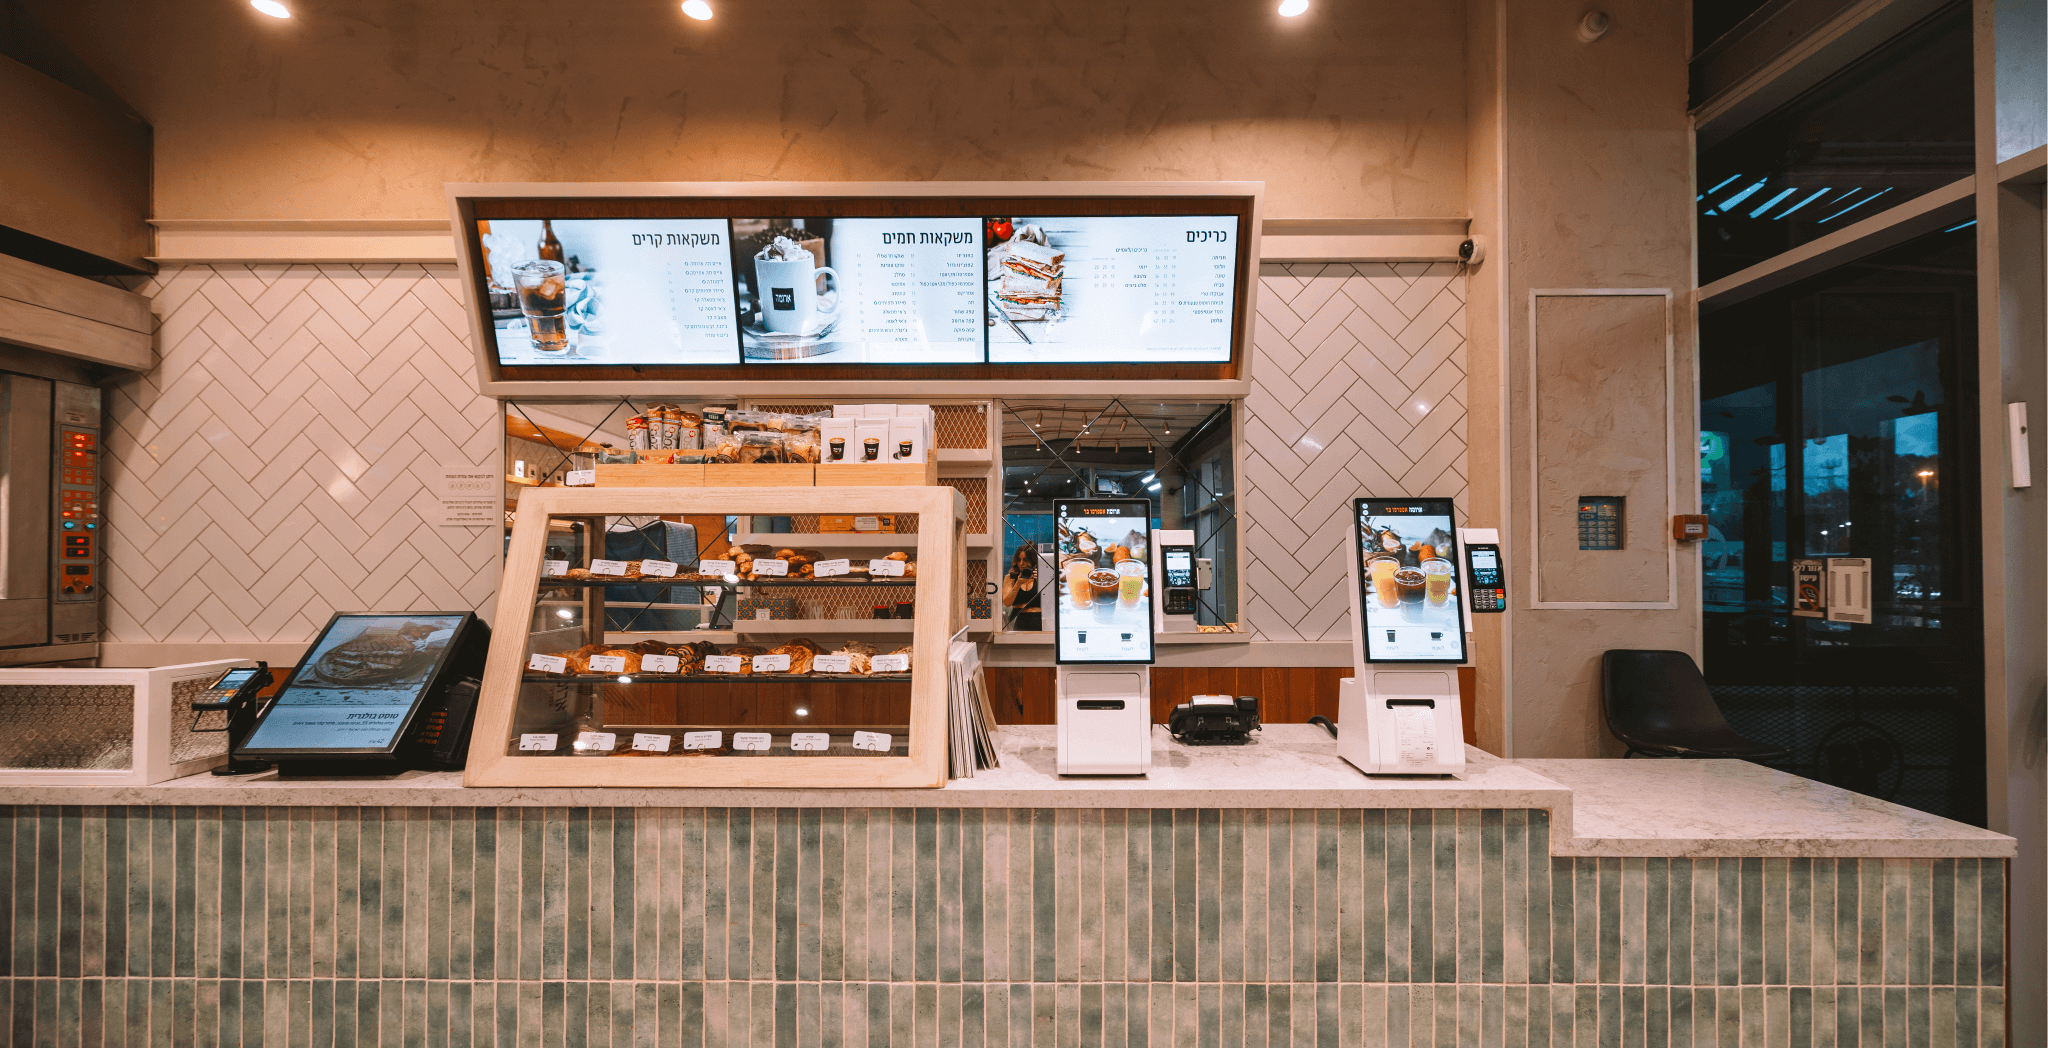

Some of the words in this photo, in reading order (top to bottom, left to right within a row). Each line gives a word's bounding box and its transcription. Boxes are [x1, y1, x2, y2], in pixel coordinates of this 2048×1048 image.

[631, 233, 662, 248] קרים
[666, 233, 720, 248] משקאות
[882, 232, 916, 244] חמים
[919, 232, 973, 247] משקאות
[1186, 231, 1227, 243] כריכים
[775, 294, 792, 304] ארומה
[1792, 564, 1806, 572] ללא
[346, 712, 377, 720] בולגרית
